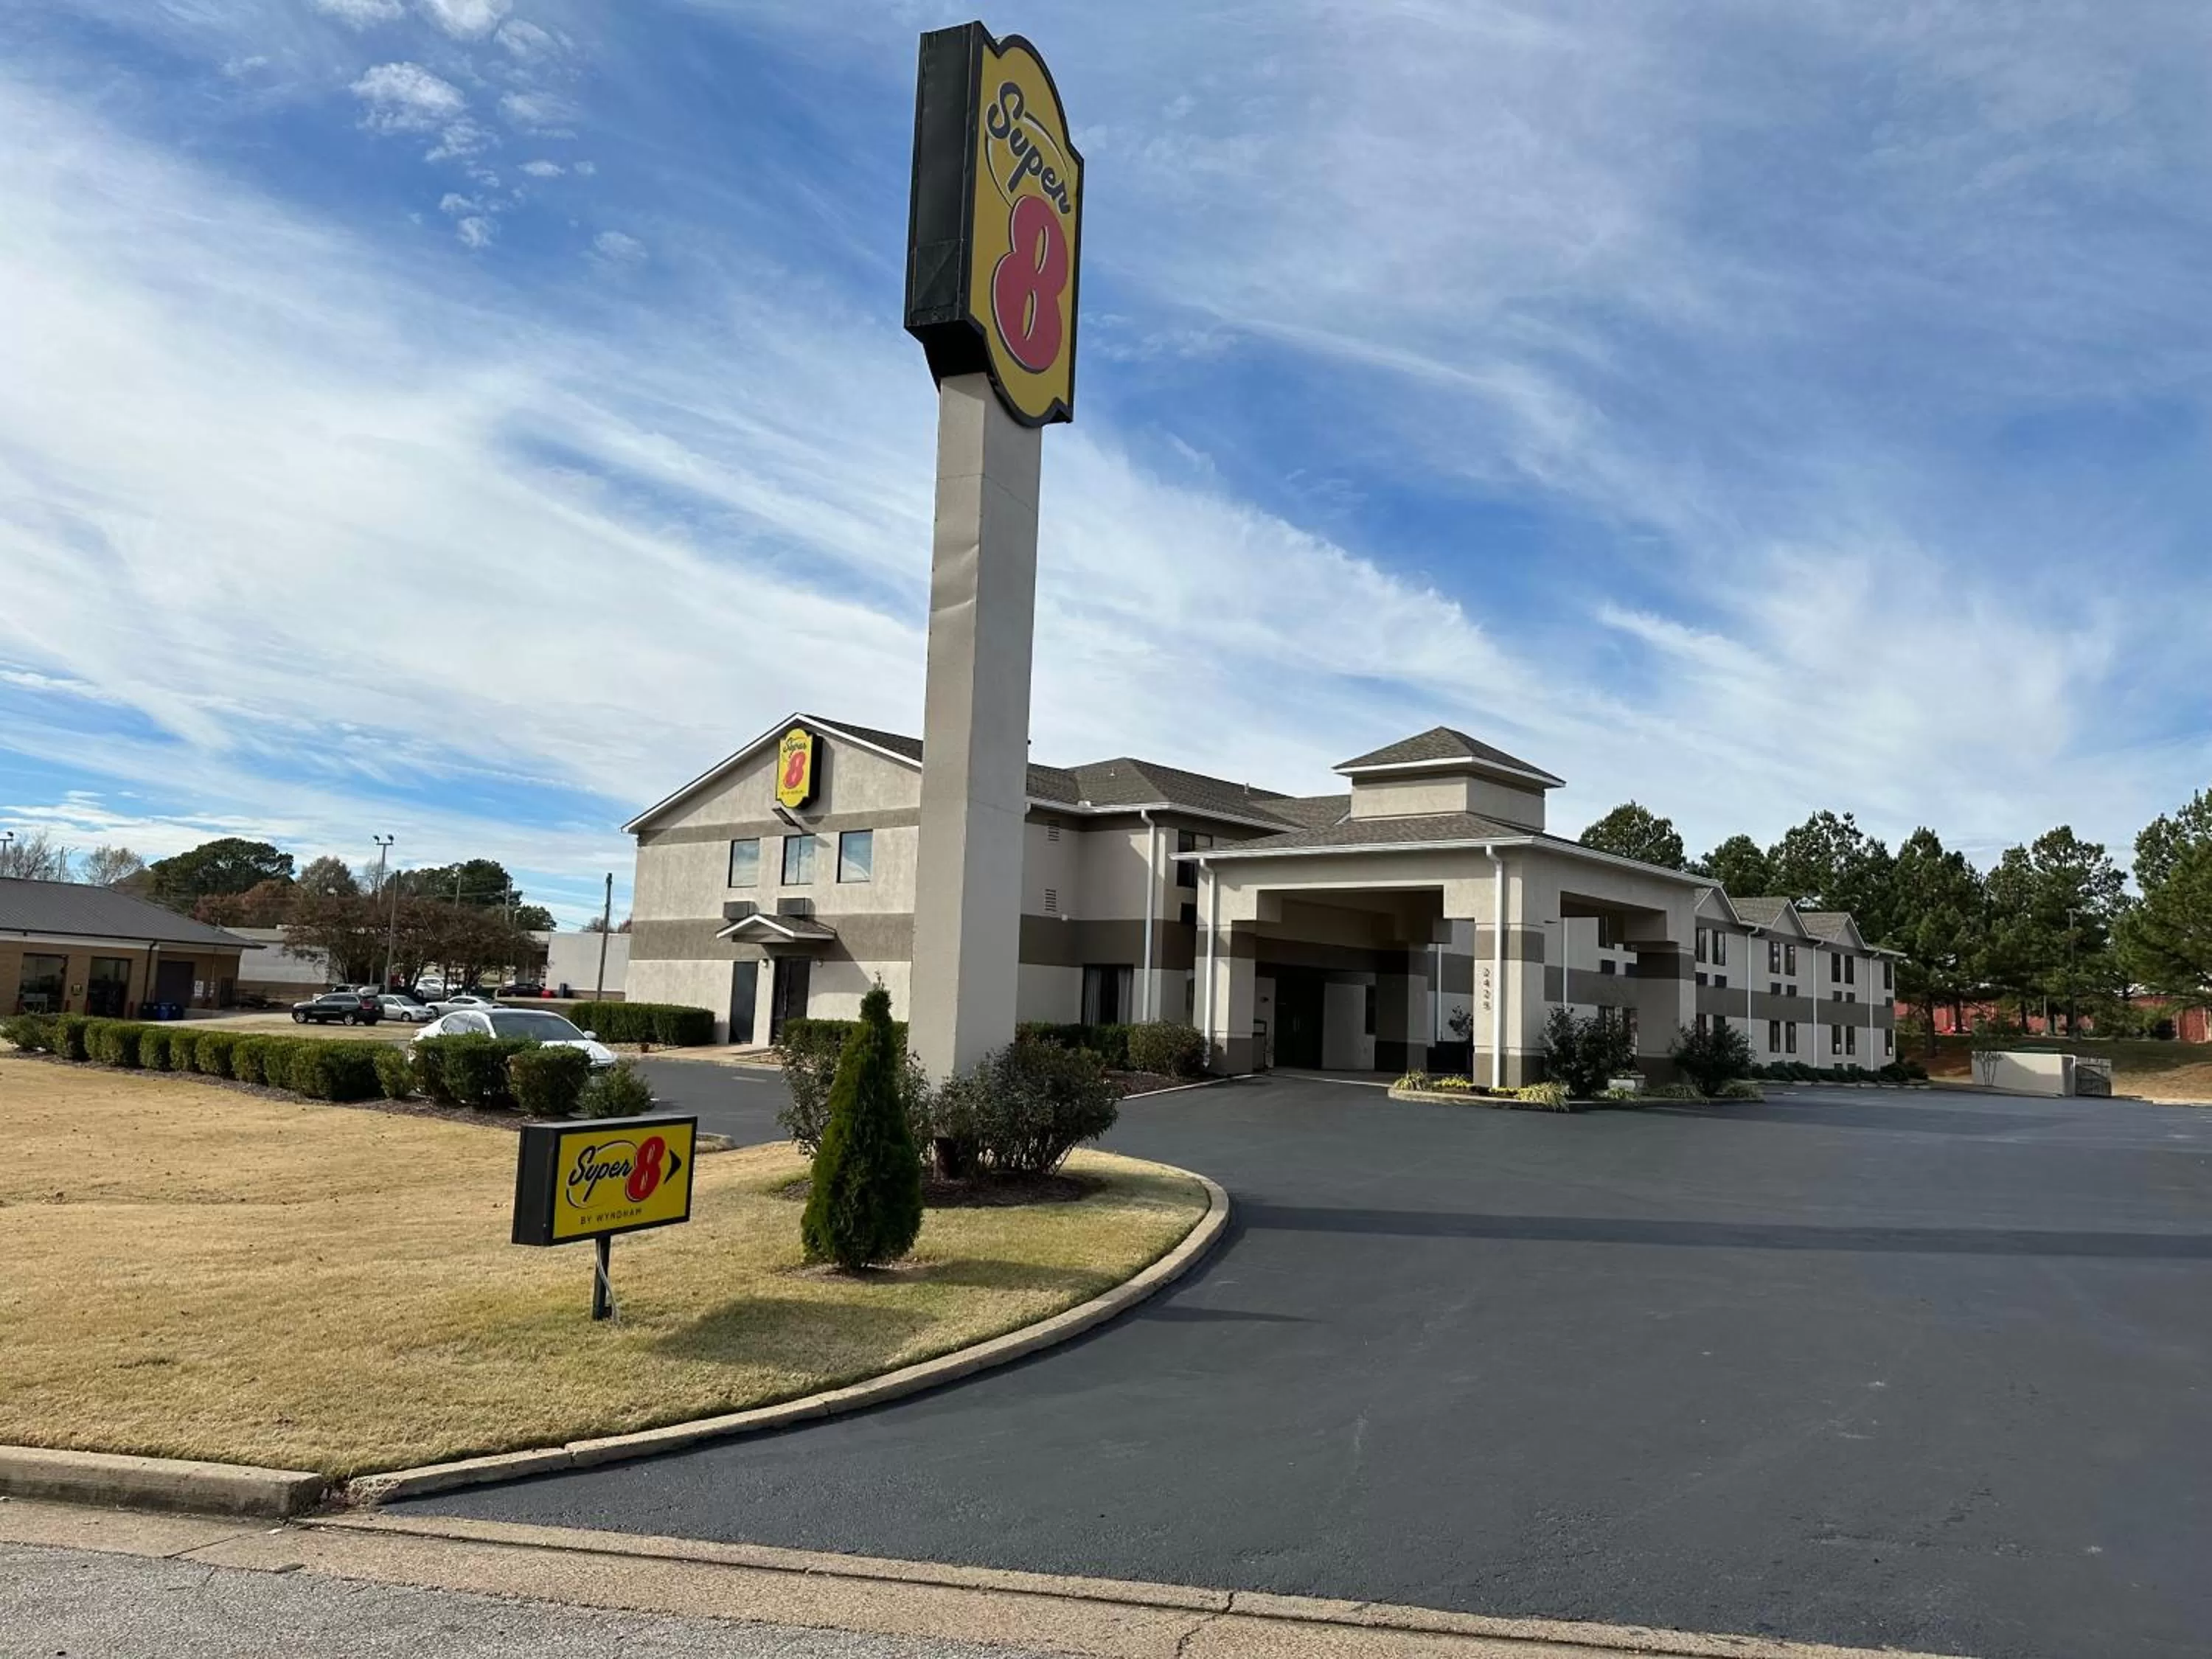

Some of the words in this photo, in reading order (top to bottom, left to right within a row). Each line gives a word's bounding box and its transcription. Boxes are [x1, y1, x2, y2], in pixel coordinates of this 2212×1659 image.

[987, 82, 1071, 215] Super
[991, 195, 1068, 375] 8
[784, 751, 806, 789] 8
[568, 1145, 633, 1203] Super
[625, 1136, 666, 1203] 8
[580, 1214, 591, 1225] BY
[597, 1207, 642, 1222] WYNDHAM
